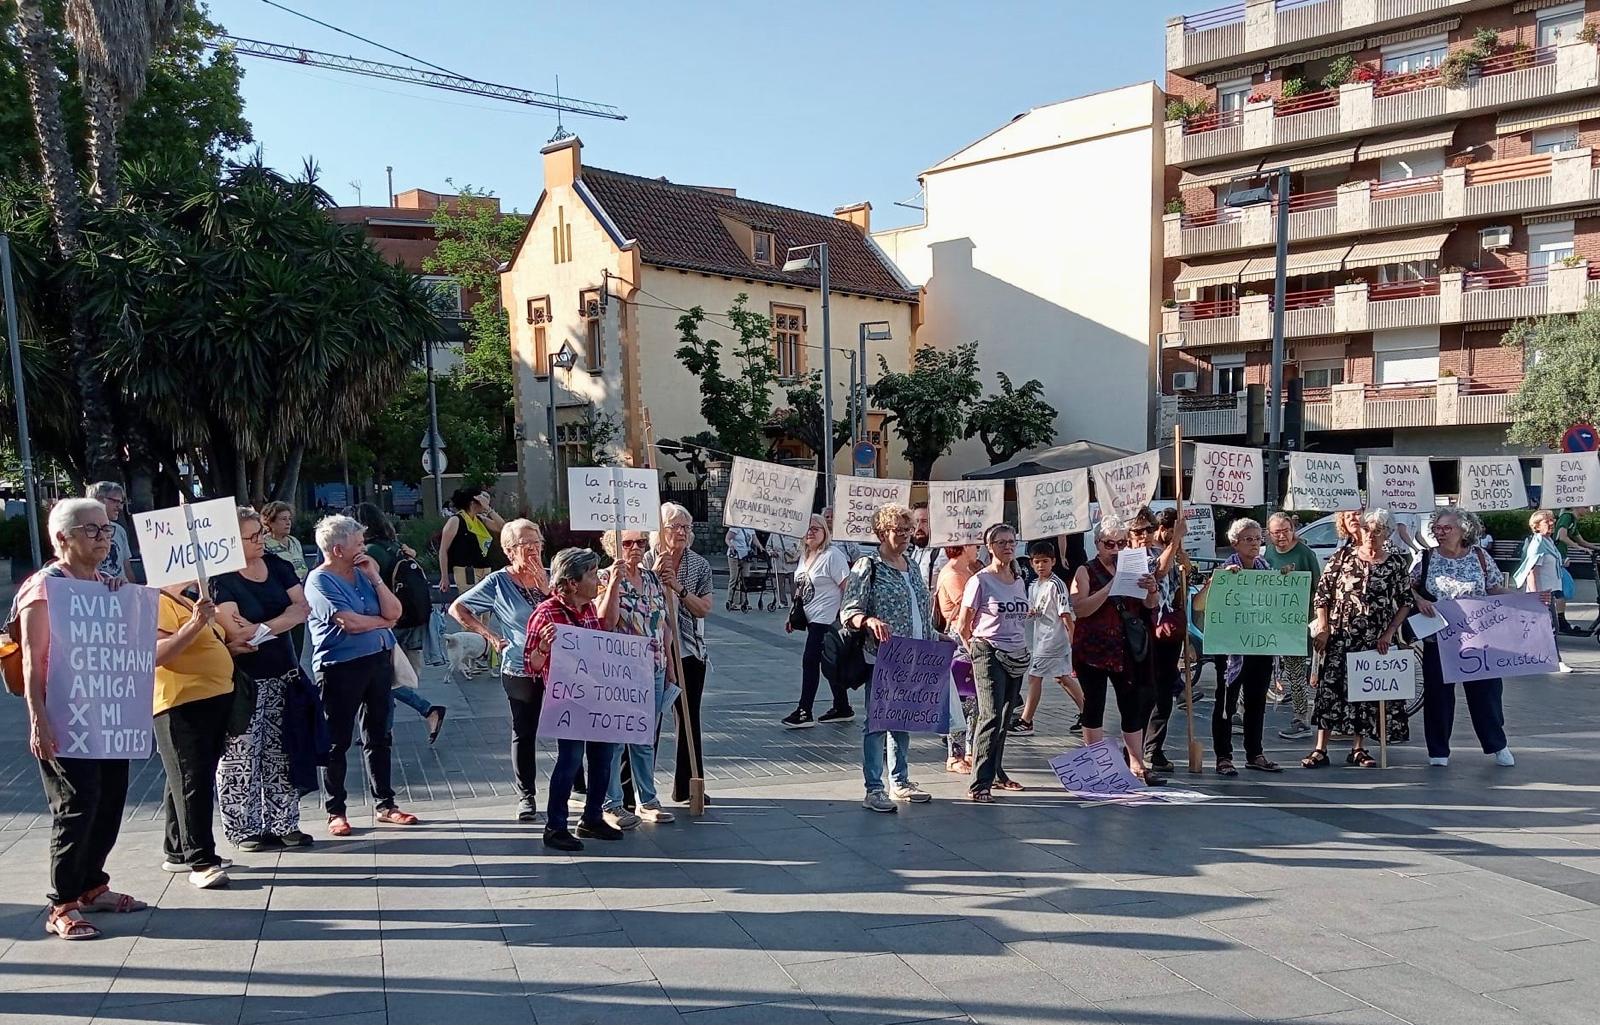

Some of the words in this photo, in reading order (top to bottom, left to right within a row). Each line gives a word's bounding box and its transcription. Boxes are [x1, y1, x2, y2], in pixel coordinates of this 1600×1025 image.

[1204, 451, 1253, 468] JOSEFA
[1307, 459, 1341, 470] DIANA
[1560, 460, 1583, 471] EVA
[1105, 461, 1151, 483] MARTA
[1210, 466, 1225, 478] 76
[1228, 470, 1251, 480] ANYS
[1383, 465, 1420, 474] JOANA
[1468, 464, 1514, 477] ANDREA
[608, 478, 648, 490] nostra
[1305, 472, 1318, 483] 48
[1320, 473, 1344, 484] ANYS
[849, 484, 899, 499] LEONOR
[1382, 489, 1416, 497] Mallorca
[1471, 488, 1512, 500] BURGOS
[1556, 485, 1585, 494] Blanes
[589, 492, 620, 505] vida
[1210, 492, 1245, 503] 6-4-25
[186, 516, 212, 531] una
[1237, 575, 1248, 585] EL
[1255, 575, 1311, 586] PRESENT
[69, 587, 123, 618] ÀVIA
[1225, 589, 1241, 606] ÉS
[1251, 593, 1300, 606] LLUITA
[997, 601, 1029, 613] som
[1210, 611, 1224, 623] EL
[1234, 612, 1272, 624] FUTUR
[70, 621, 128, 644] MARE
[593, 636, 650, 657] TOQUEN
[70, 647, 153, 673] GERMANA
[1355, 659, 1370, 671] NO
[1375, 658, 1408, 672] ESTAS
[576, 658, 588, 674] A
[602, 662, 632, 680] UNA
[69, 675, 136, 699] AMIGA
[1361, 676, 1399, 692] SOLA
[552, 681, 585, 699] ENS
[593, 685, 649, 703] TOQUEN
[68, 703, 90, 726] X
[101, 703, 121, 726] MI
[557, 710, 571, 727] A
[588, 712, 648, 732] TOTES
[67, 731, 90, 753] X
[101, 729, 148, 753] TOTES
